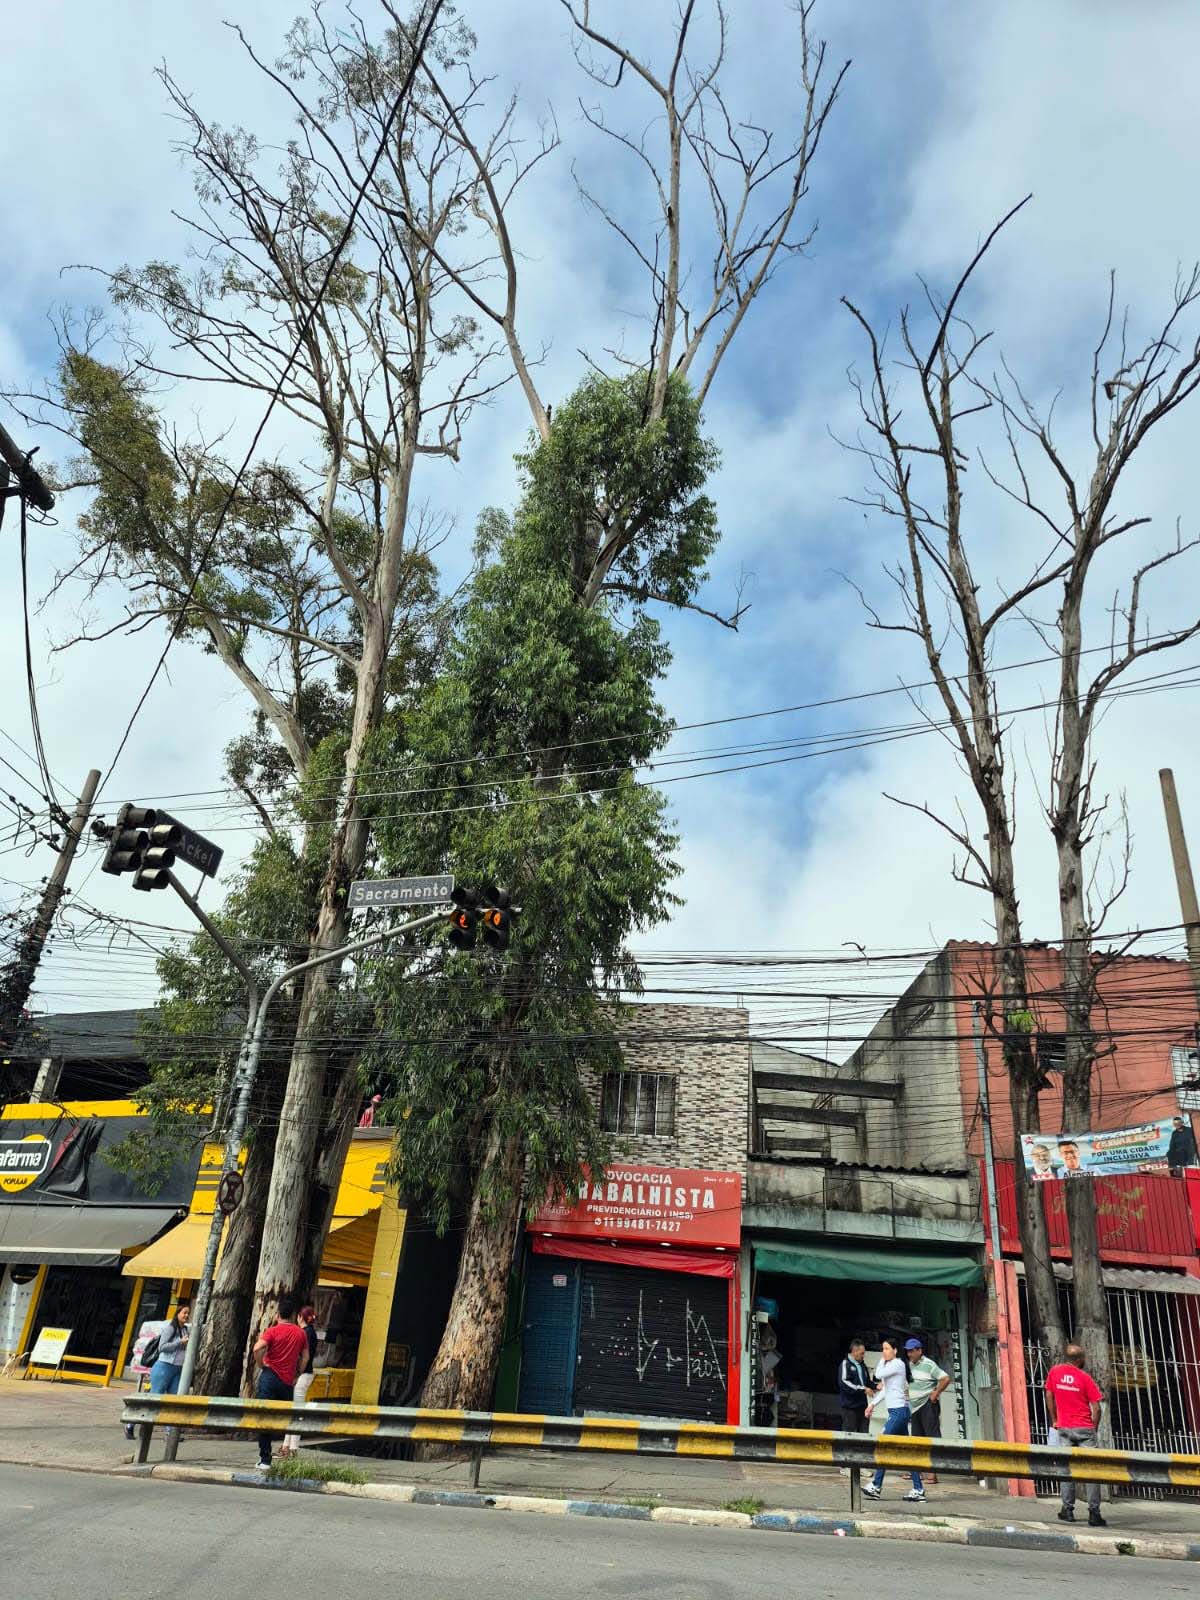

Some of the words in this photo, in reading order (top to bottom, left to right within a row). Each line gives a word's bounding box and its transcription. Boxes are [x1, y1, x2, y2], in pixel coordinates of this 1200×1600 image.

[354, 882, 448, 902] Sacramento
[1109, 1148, 1128, 1156] UMA
[1129, 1145, 1160, 1154] CIDADE
[1103, 1152, 1150, 1162] INCLUSIVA
[3, 1177, 28, 1185] POPULAR
[603, 1170, 672, 1185] DVOCACIA
[578, 1181, 715, 1209] RABALHISTA
[1060, 1374, 1075, 1384] JD
